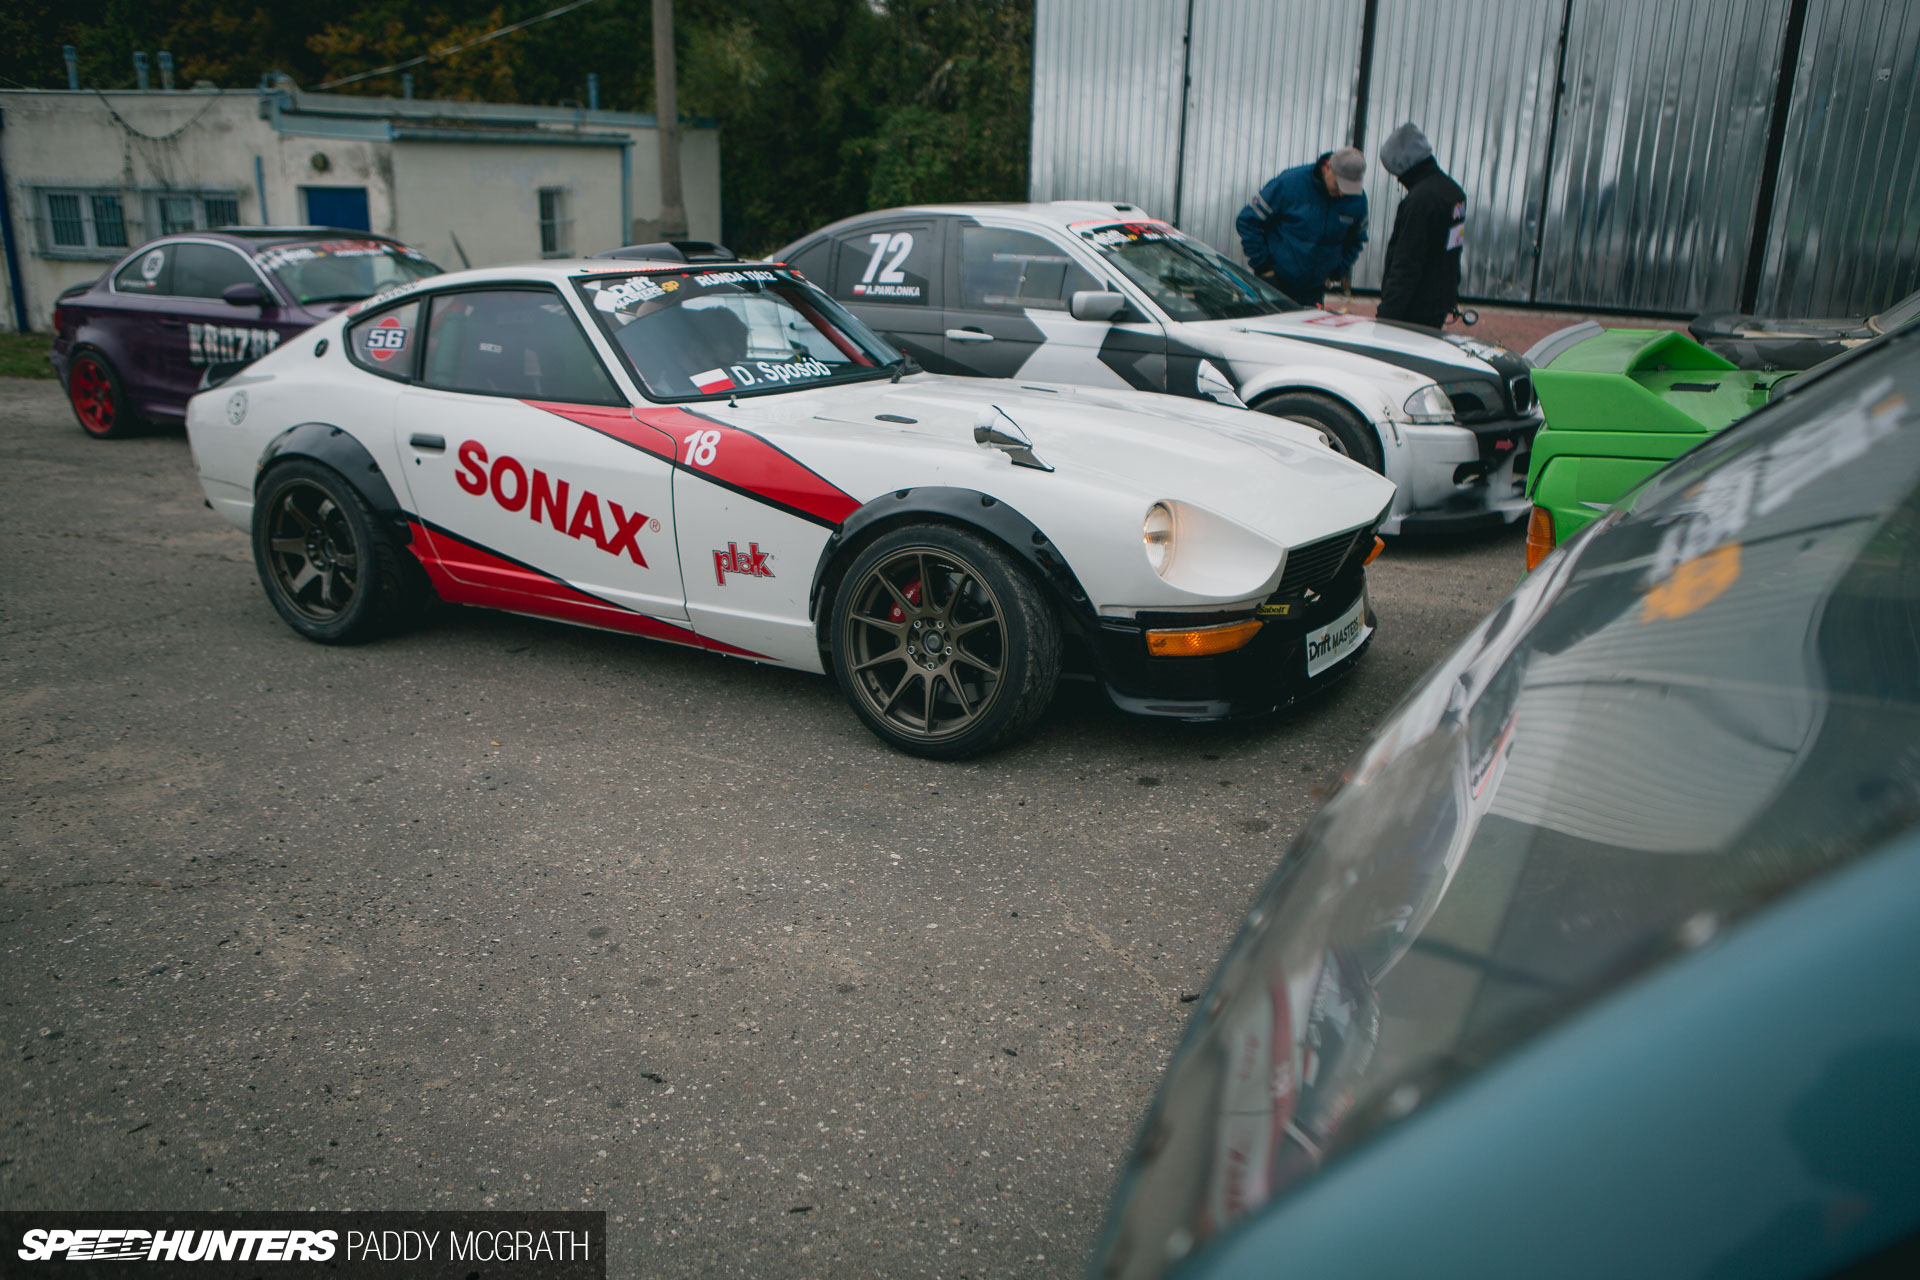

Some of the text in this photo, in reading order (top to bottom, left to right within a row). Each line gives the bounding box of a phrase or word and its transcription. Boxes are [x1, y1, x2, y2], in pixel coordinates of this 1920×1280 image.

[862, 232, 914, 283] 72
[694, 271, 748, 287] RUNDA
[367, 329, 404, 349] 56
[730, 357, 832, 386] D. Sposób
[683, 430, 722, 466] 18
[455, 439, 650, 570] SONAX
[712, 541, 776, 587] plak
[1308, 634, 1332, 662] Drift
[1332, 617, 1358, 649] MASTERS
